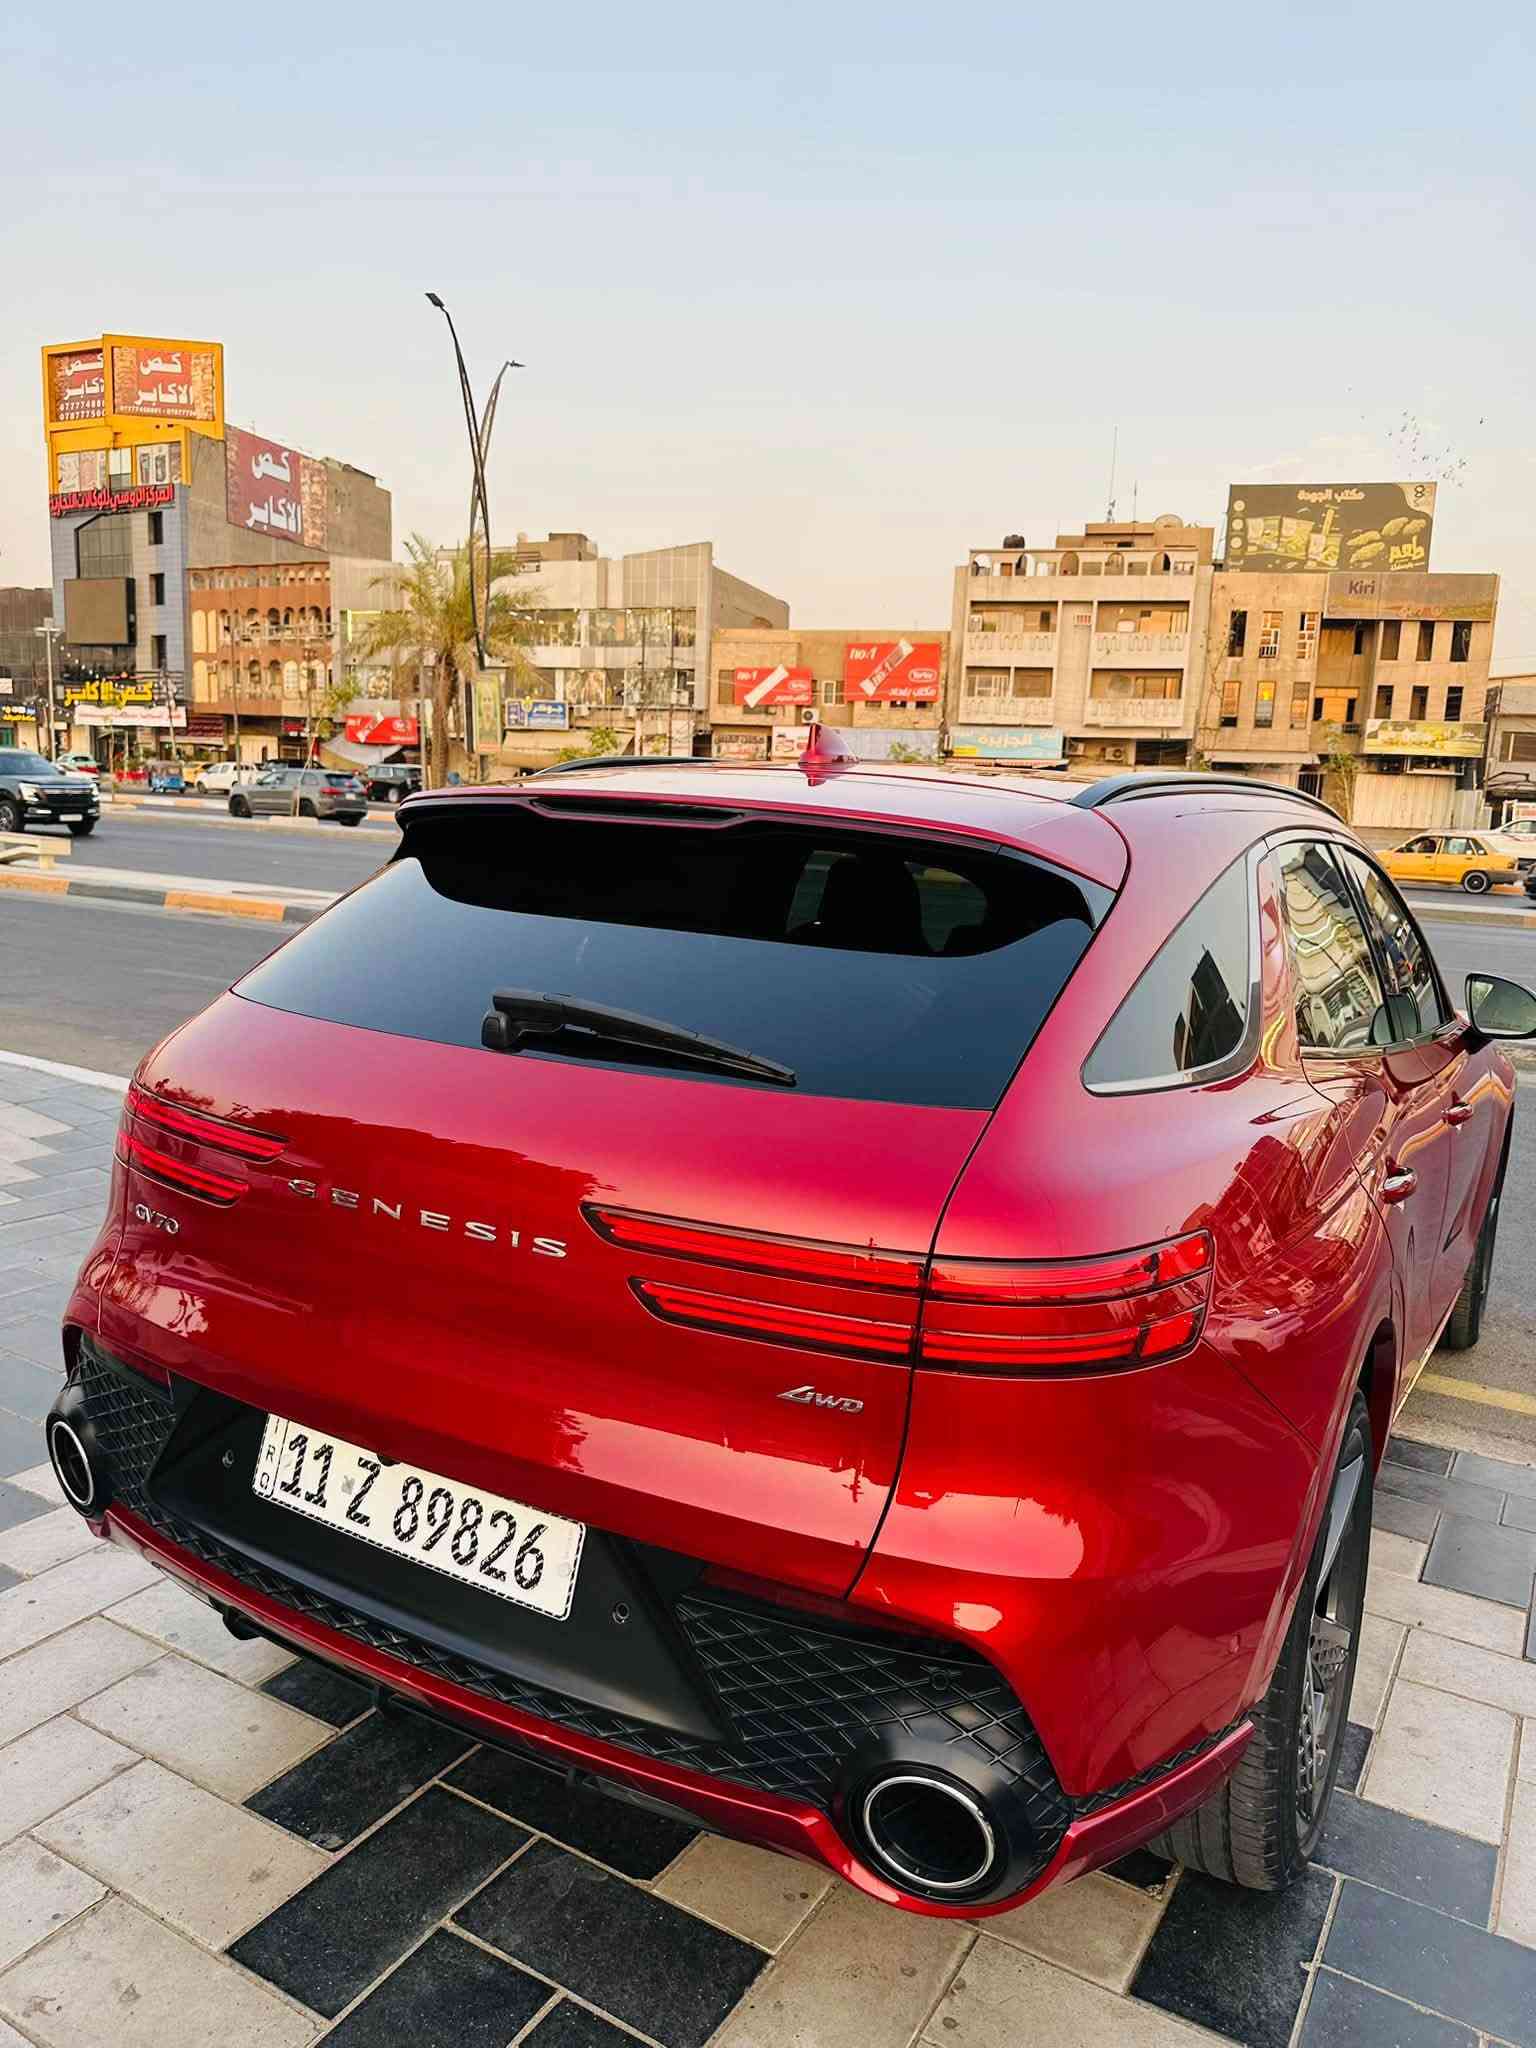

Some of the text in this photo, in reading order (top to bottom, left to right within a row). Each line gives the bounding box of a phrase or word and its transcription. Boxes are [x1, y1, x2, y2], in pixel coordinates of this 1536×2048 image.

[140, 353, 182, 376] كص
[252, 450, 291, 480] كص
[1348, 579, 1376, 595] Kiri
[287, 1179, 568, 1258] GENESIS
[776, 1385, 865, 1413] 4WD
[281, 1433, 550, 1591] 11 Z 89826
